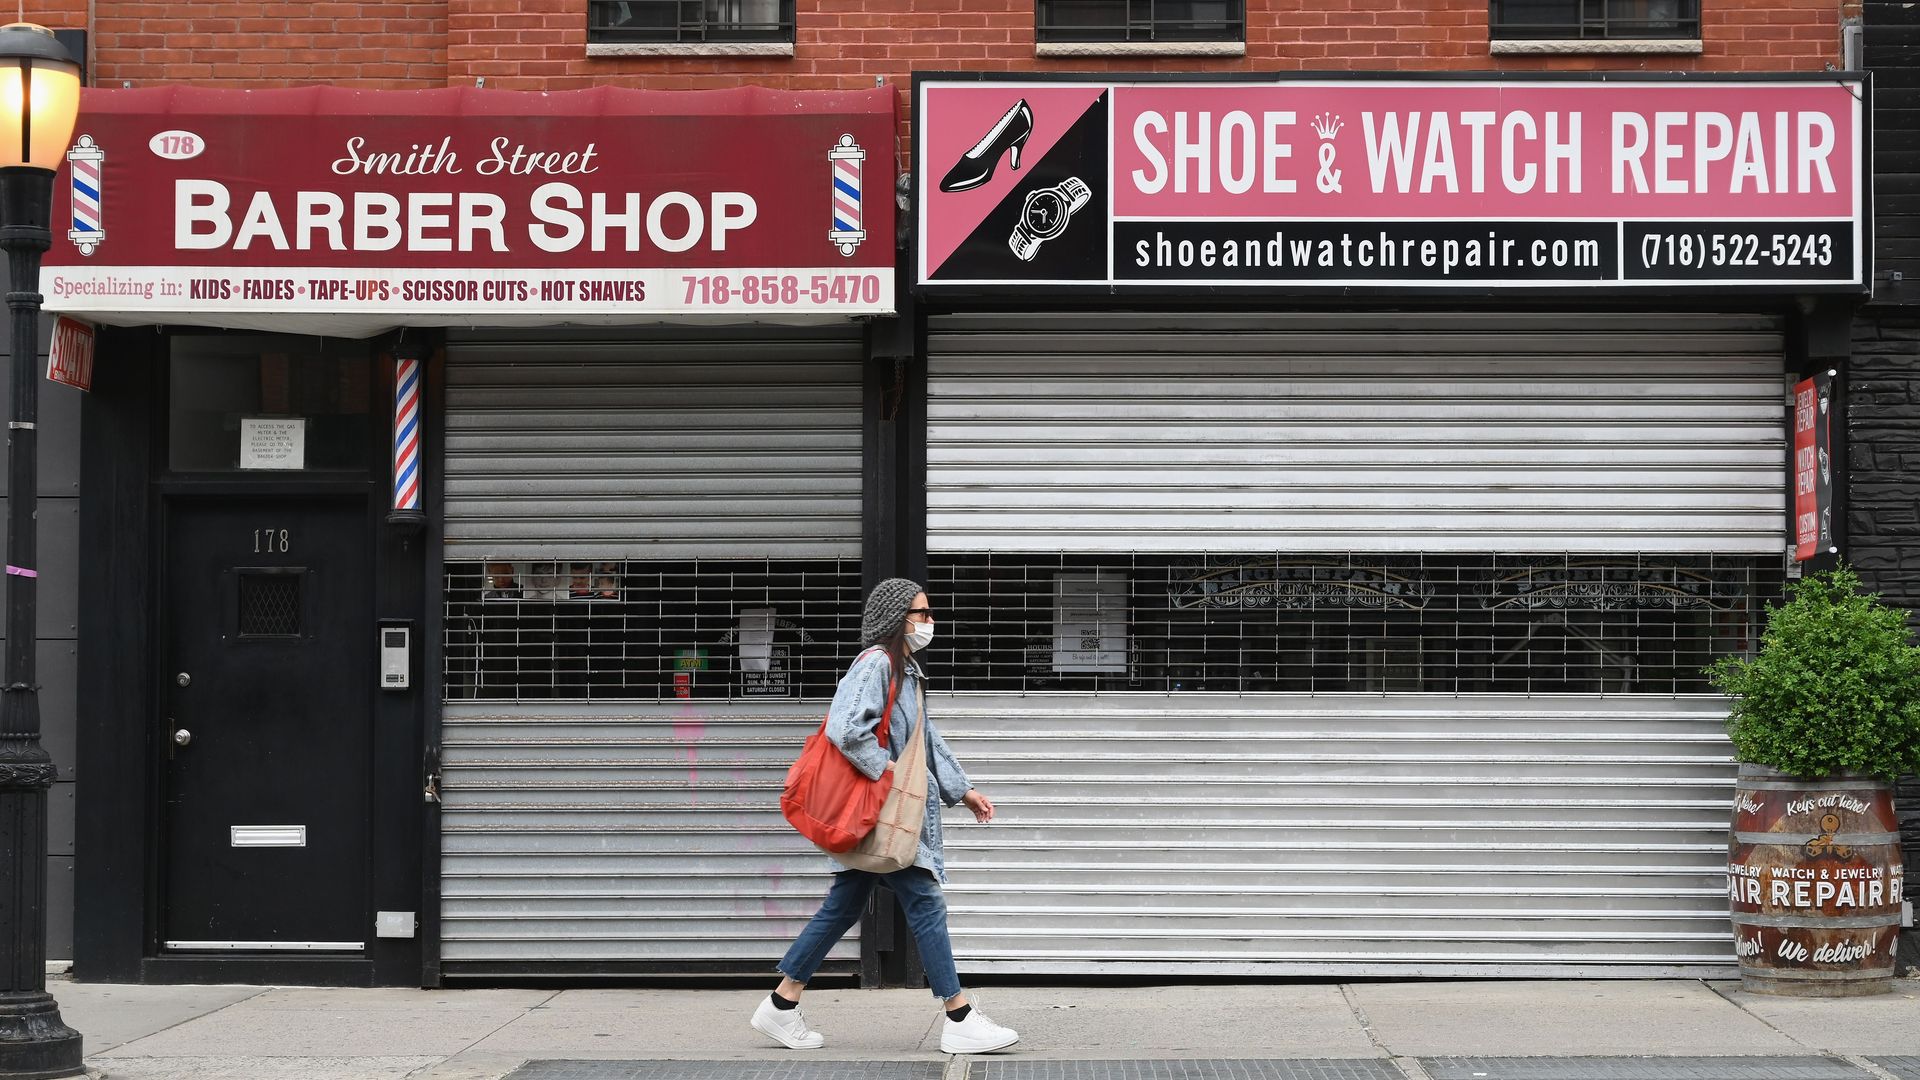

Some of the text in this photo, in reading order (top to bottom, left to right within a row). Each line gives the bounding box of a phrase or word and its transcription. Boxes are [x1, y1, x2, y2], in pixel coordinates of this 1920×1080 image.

[160, 135, 195, 155] 178
[331, 136, 599, 175] Smith Street
[1132, 110, 1837, 194] SHOE & WATCH REPAIR
[175, 179, 758, 252] BARBER SHOP
[1135, 231, 1600, 275] shoeandwatchrepair.com
[53, 277, 645, 302] Specializing in: KIDS FADES TAPE-UPS SCISSOR CUTS HOT SHAVES
[682, 275, 881, 304] 718-858-5470
[254, 529, 289, 553] 178
[1786, 799, 1815, 816] Keys
[1818, 794, 1838, 807] cut
[1838, 795, 1871, 815] here!
[1771, 867, 1884, 880] WATCH & JEWELRY
[1771, 879, 1884, 908] REPAIR
[1778, 938, 1809, 962] We
[1813, 931, 1877, 964] deliver!
